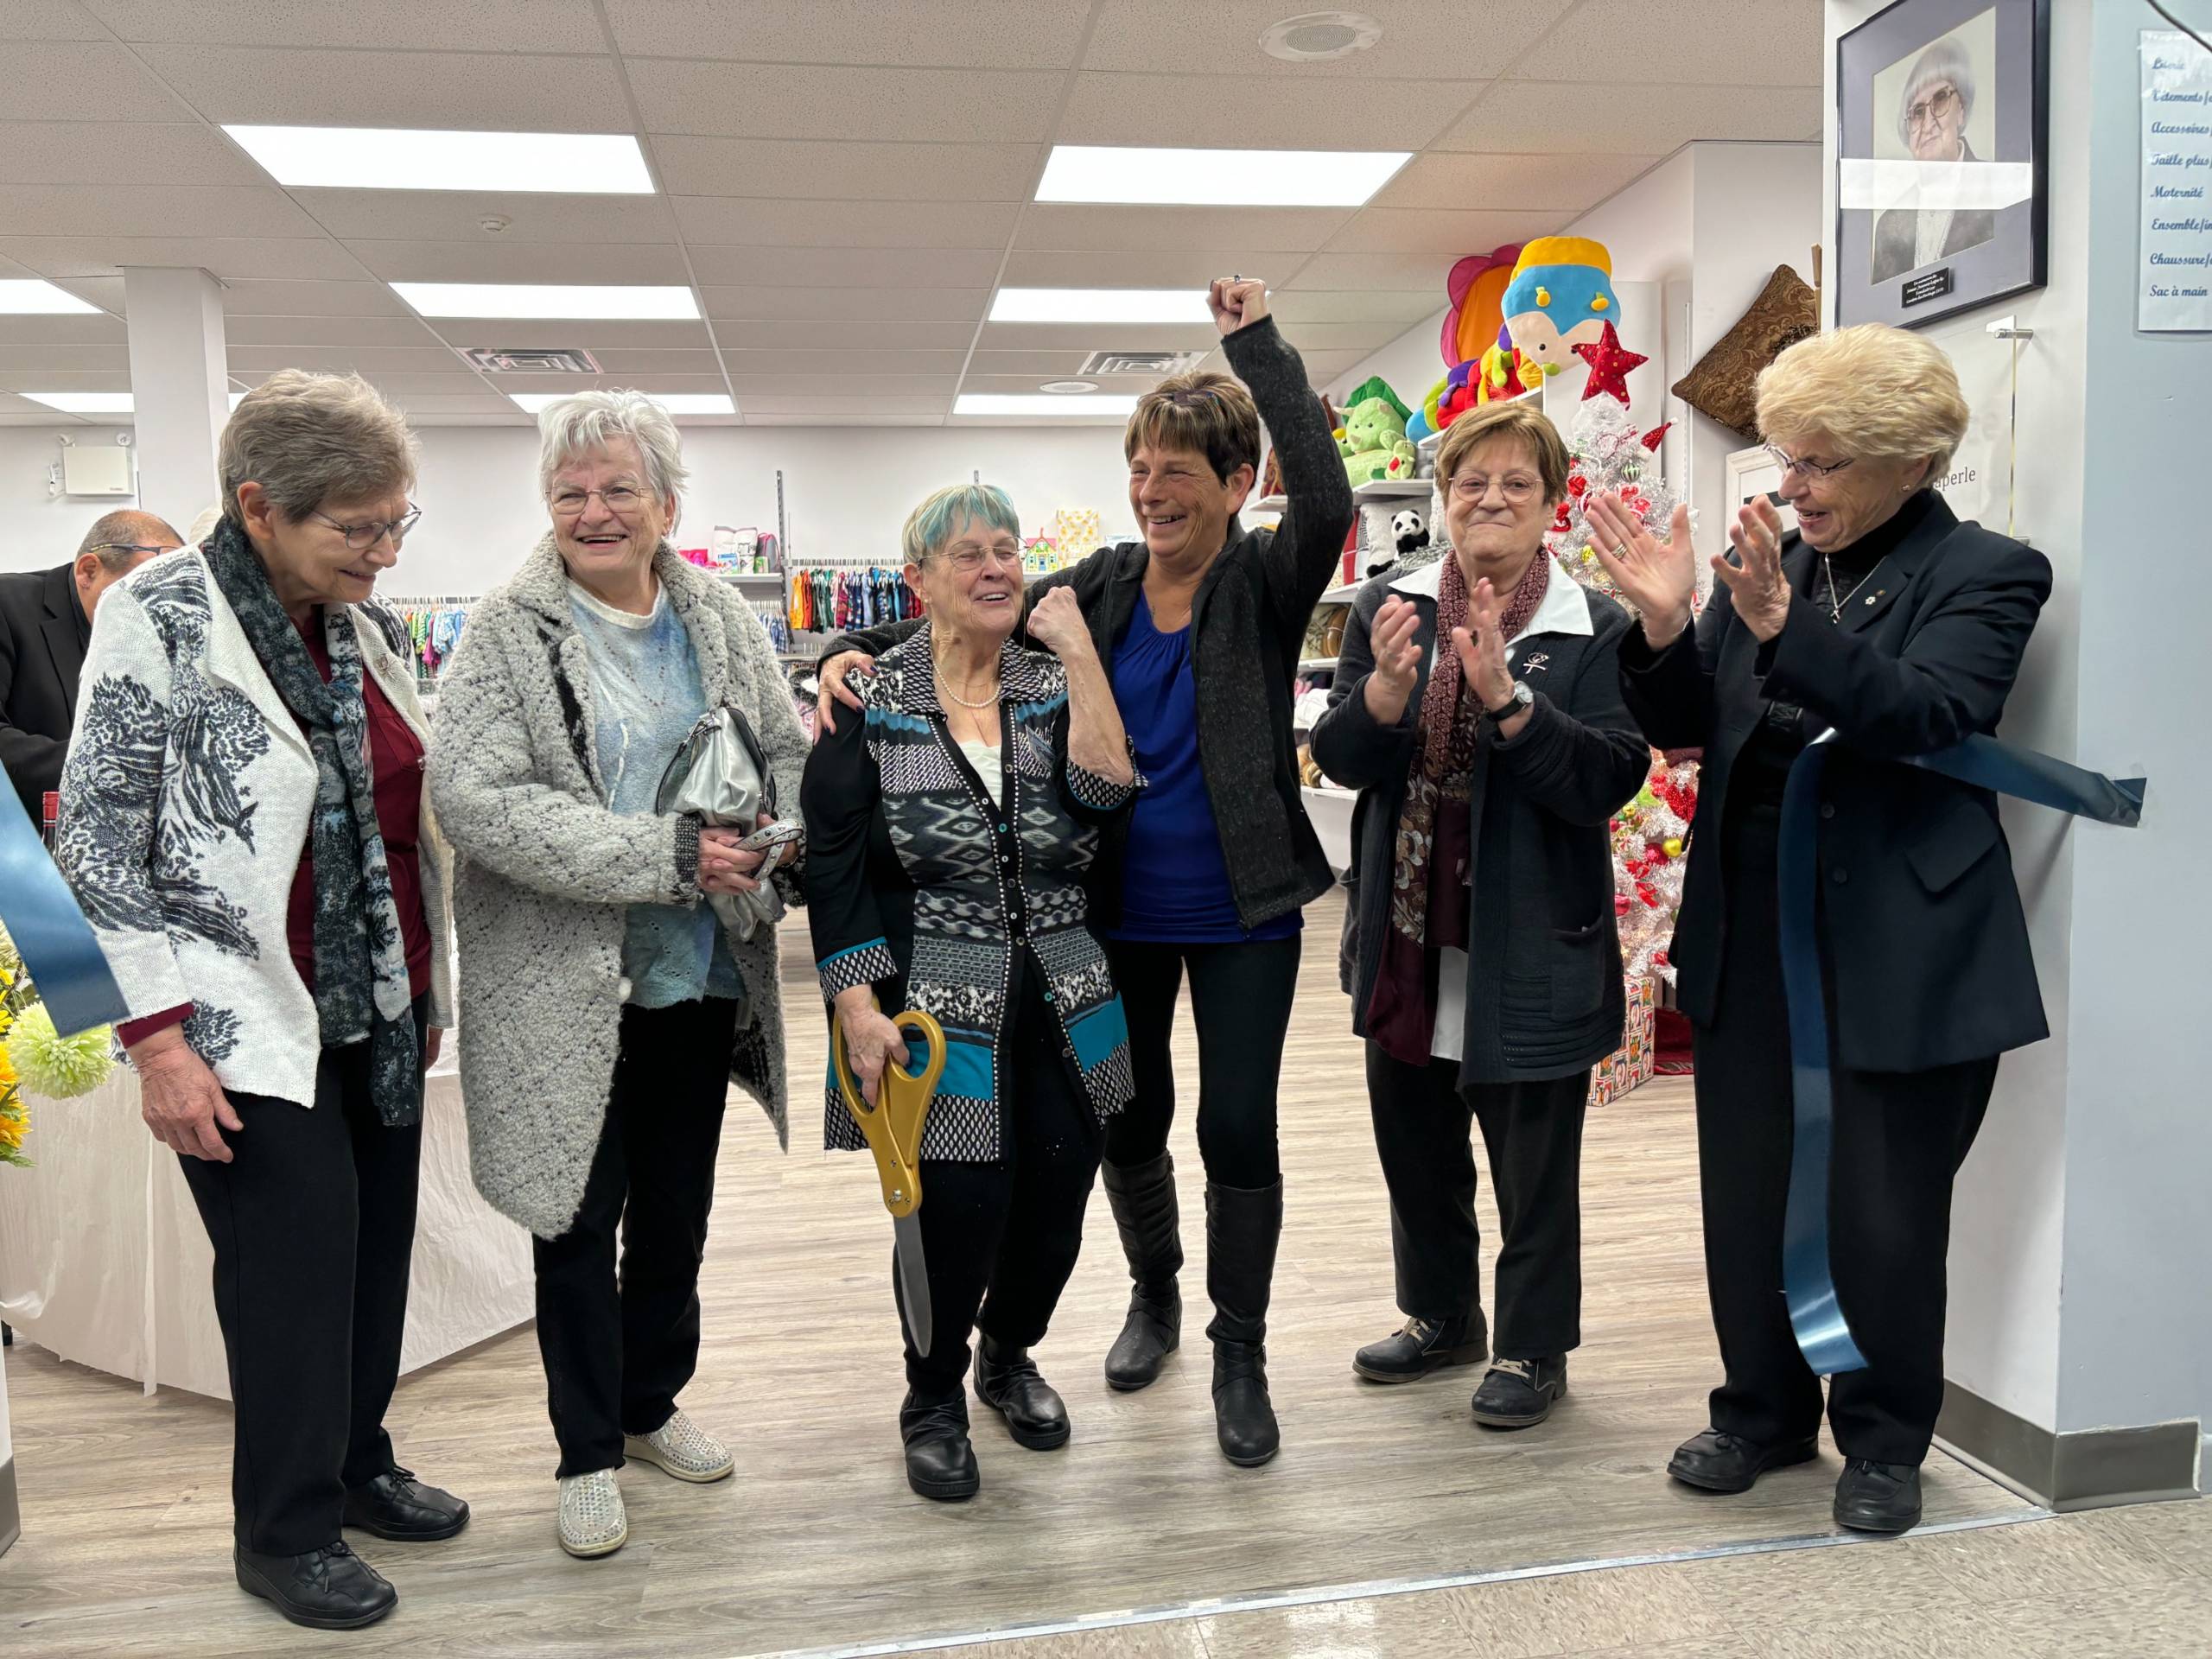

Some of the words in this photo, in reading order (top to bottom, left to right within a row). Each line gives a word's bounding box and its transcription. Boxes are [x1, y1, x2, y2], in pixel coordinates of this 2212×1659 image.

[2152, 153, 2183, 165] Taille
[2150, 185, 2204, 198] Maternité
[2150, 284, 2170, 296] Sac
[2171, 285, 2179, 296] à
[2181, 286, 2208, 296] main
